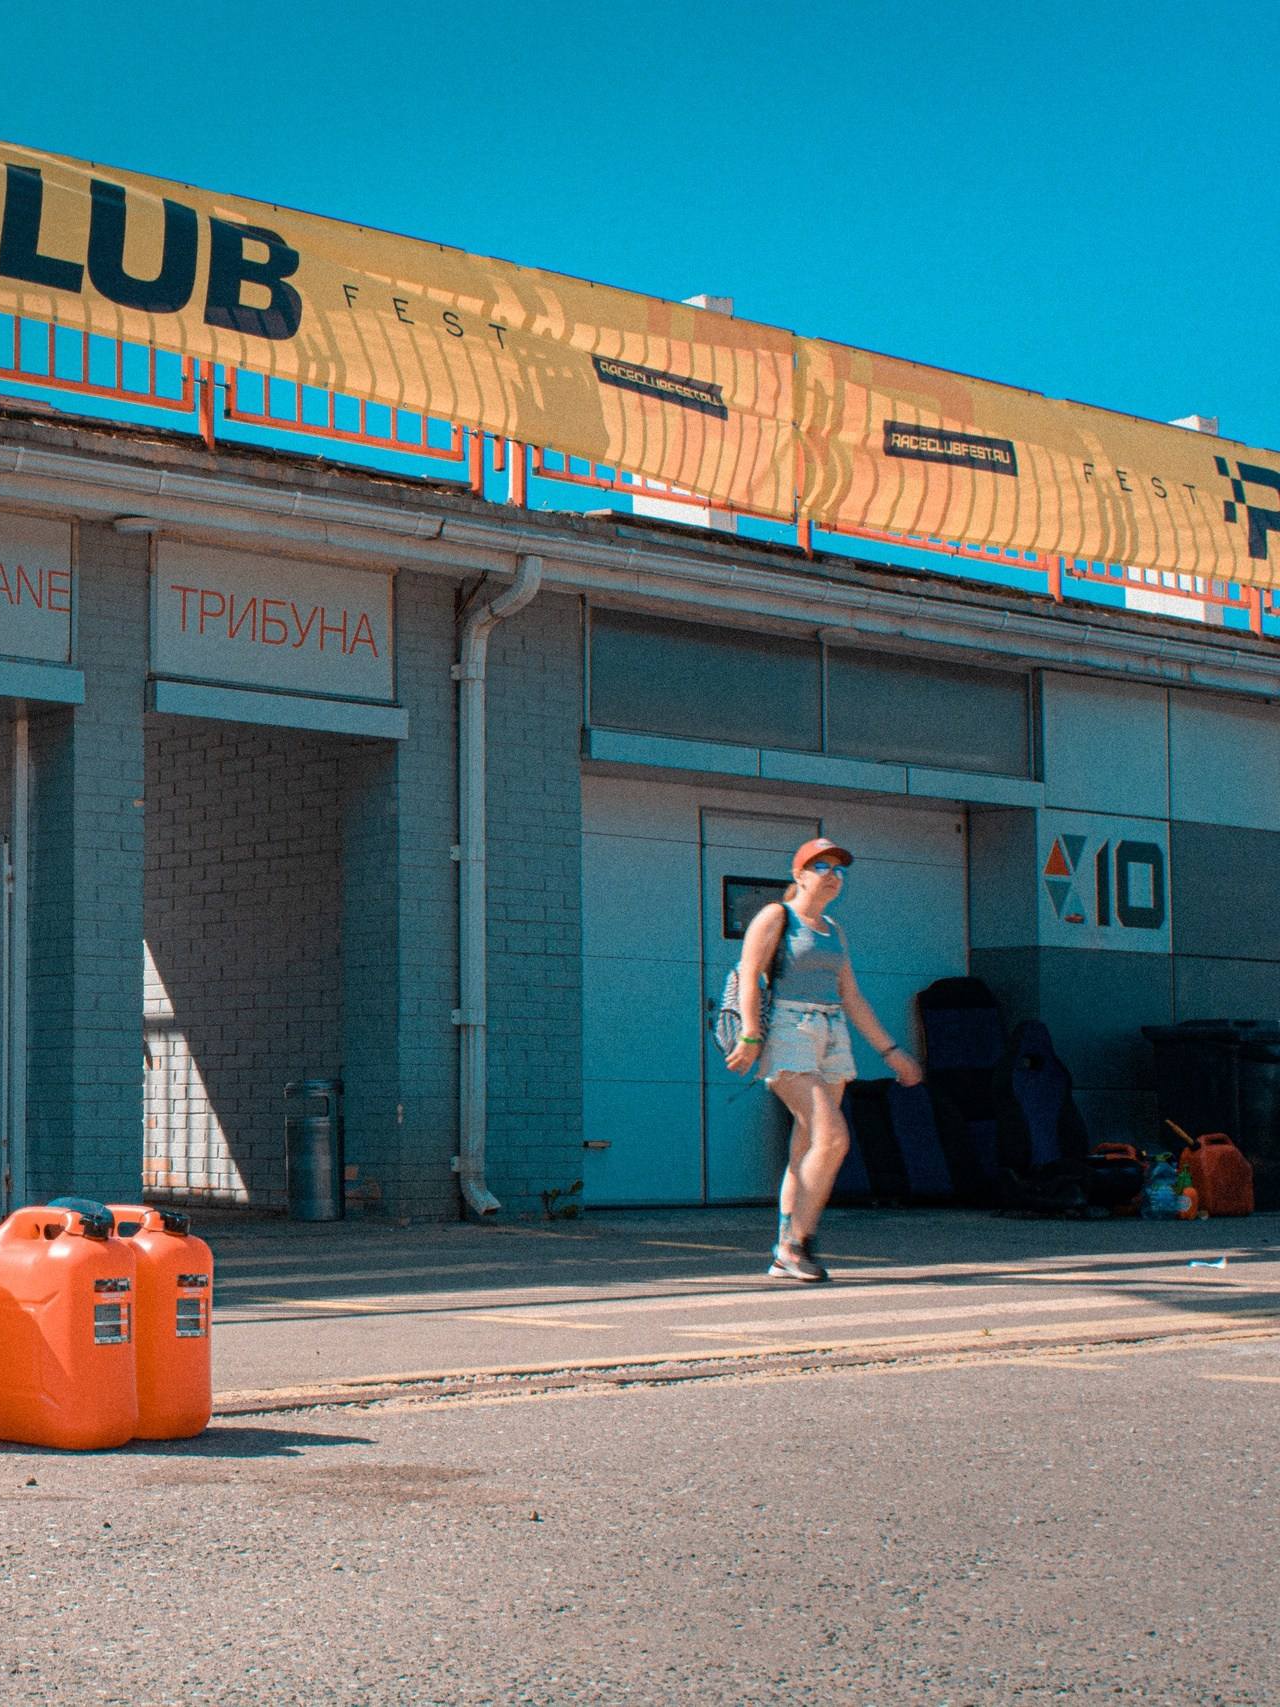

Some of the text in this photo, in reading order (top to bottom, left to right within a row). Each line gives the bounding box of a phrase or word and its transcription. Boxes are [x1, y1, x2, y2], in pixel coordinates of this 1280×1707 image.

[342, 283, 508, 350] FEST
[891, 431, 1012, 465] RACECLUBFEST.RU
[1082, 461, 1197, 506] FEST
[169, 584, 380, 659] ТРИБУНА
[1095, 837, 1166, 930] 10
